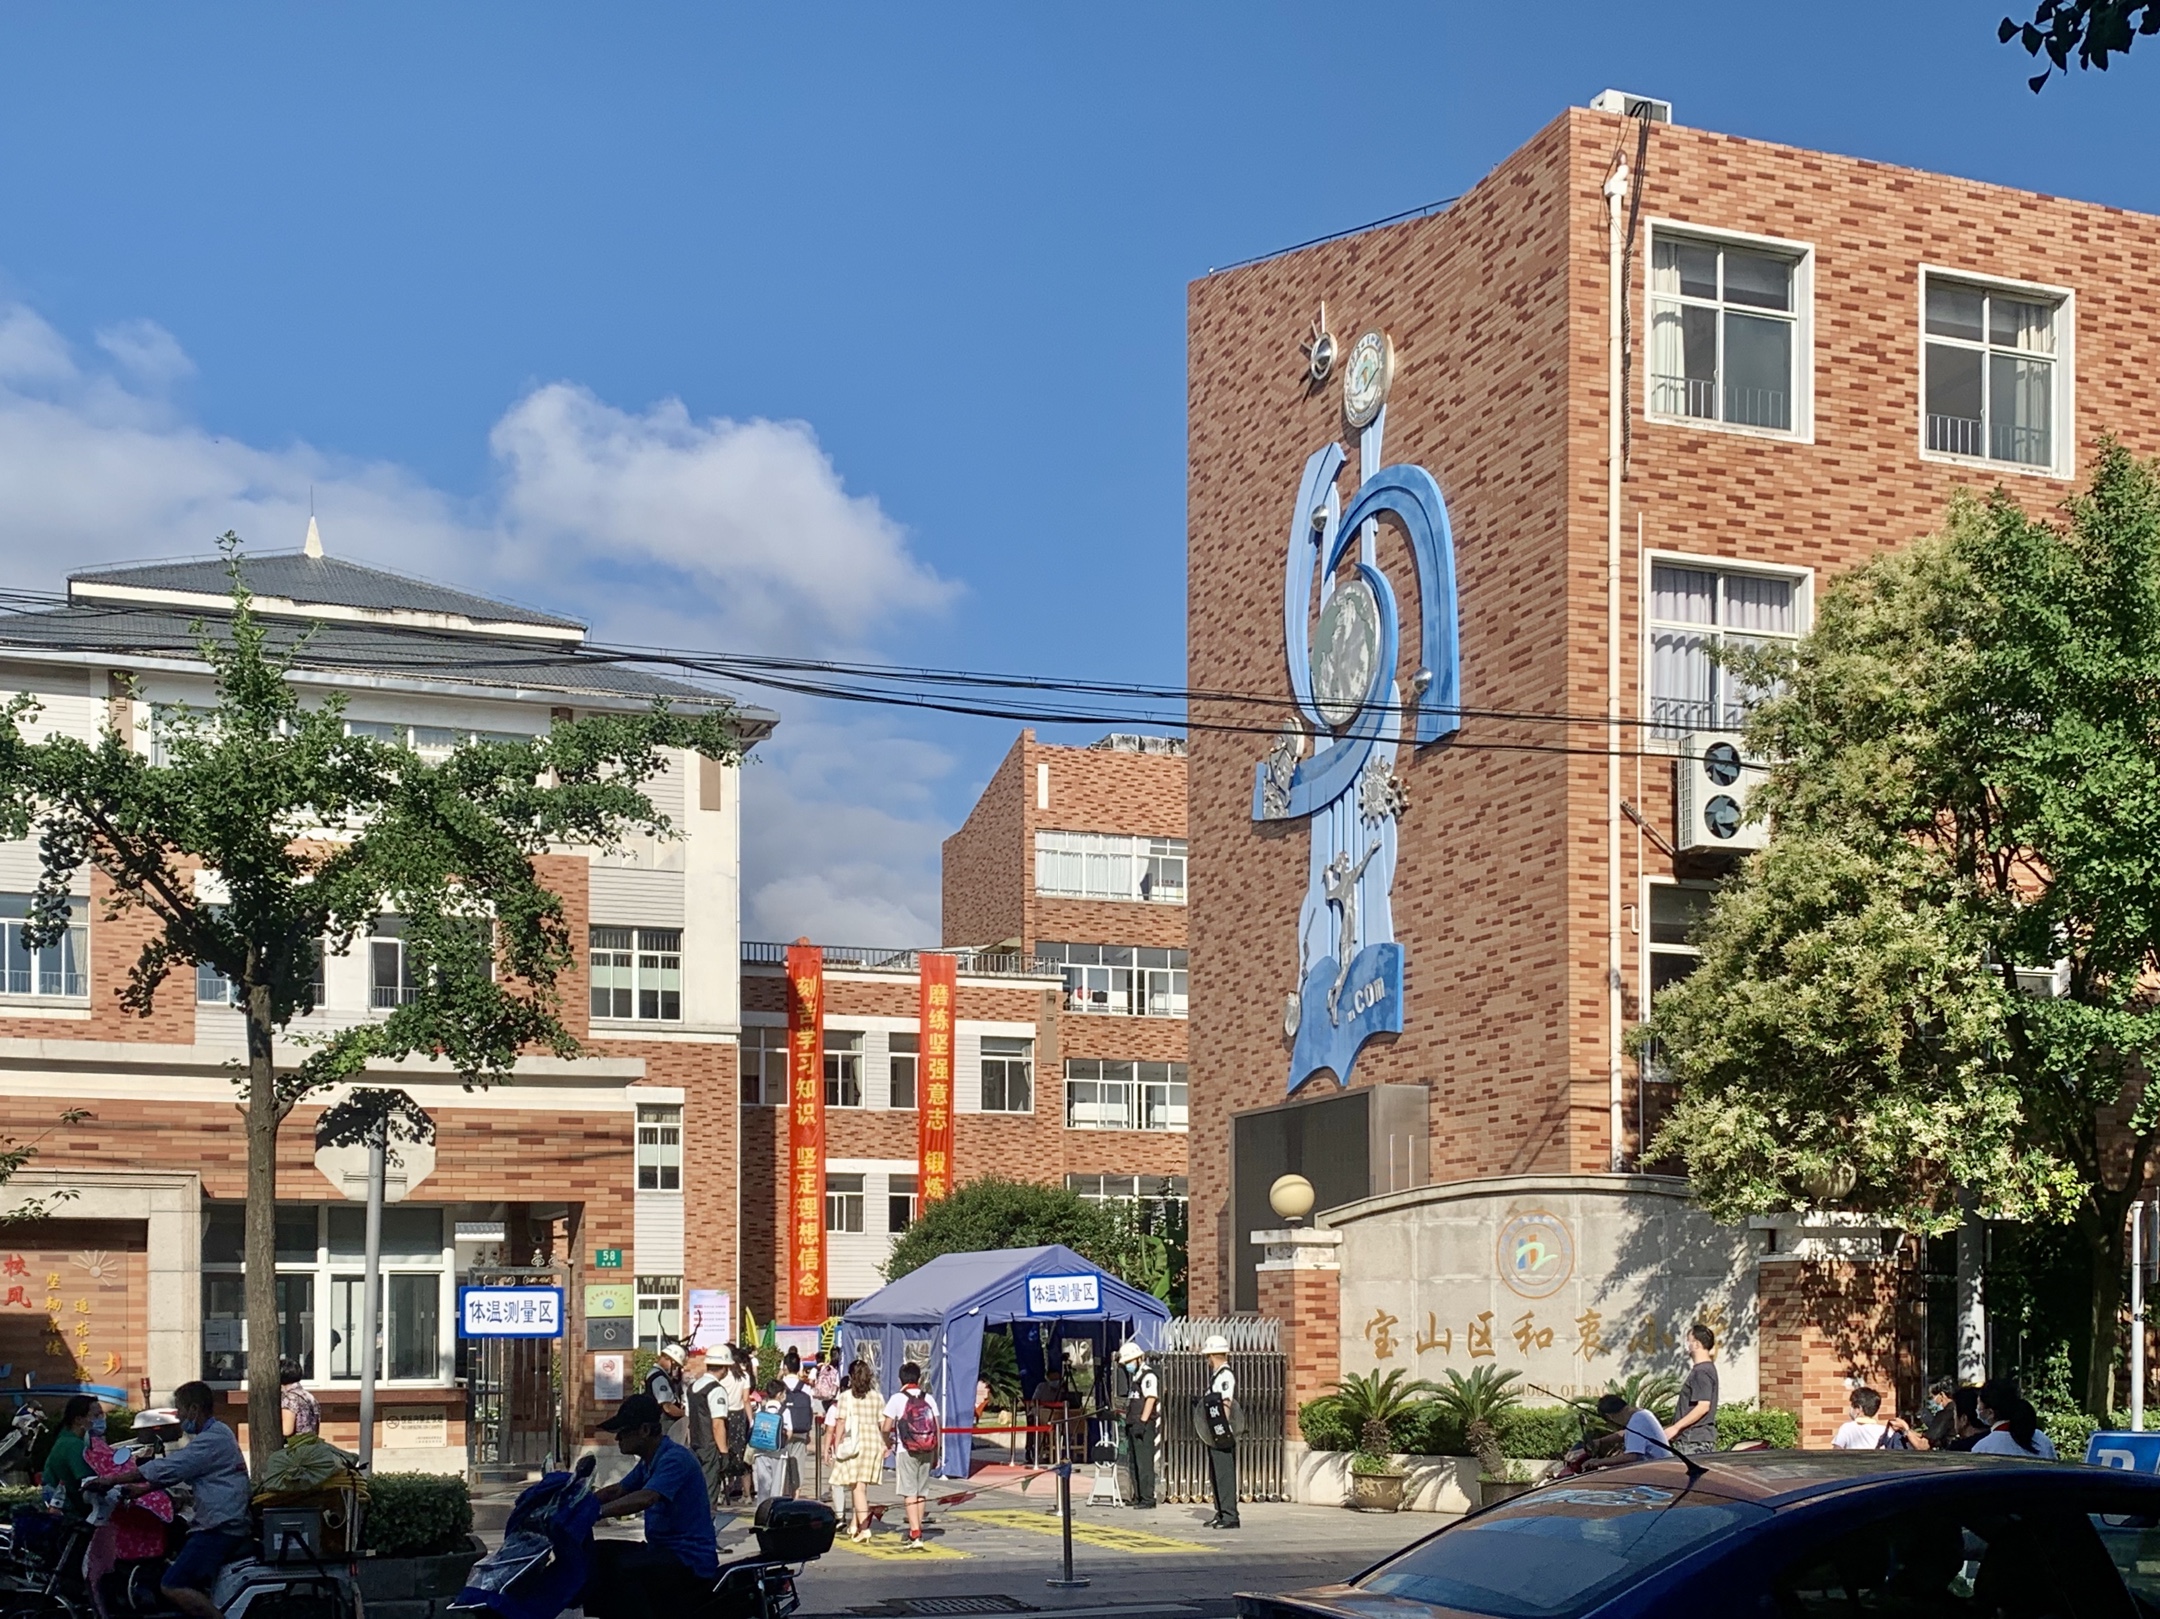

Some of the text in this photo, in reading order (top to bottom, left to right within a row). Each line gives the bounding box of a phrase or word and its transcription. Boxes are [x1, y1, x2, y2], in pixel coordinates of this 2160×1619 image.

[927, 984, 949, 1130] 磨练坚强意志
[796, 976, 820, 1296] 刻苦学习知识 坚定理想信念
[603, 1250, 616, 1261] 58
[1032, 1283, 1095, 1304] 体温测量区
[469, 1300, 554, 1324] 体温测量区
